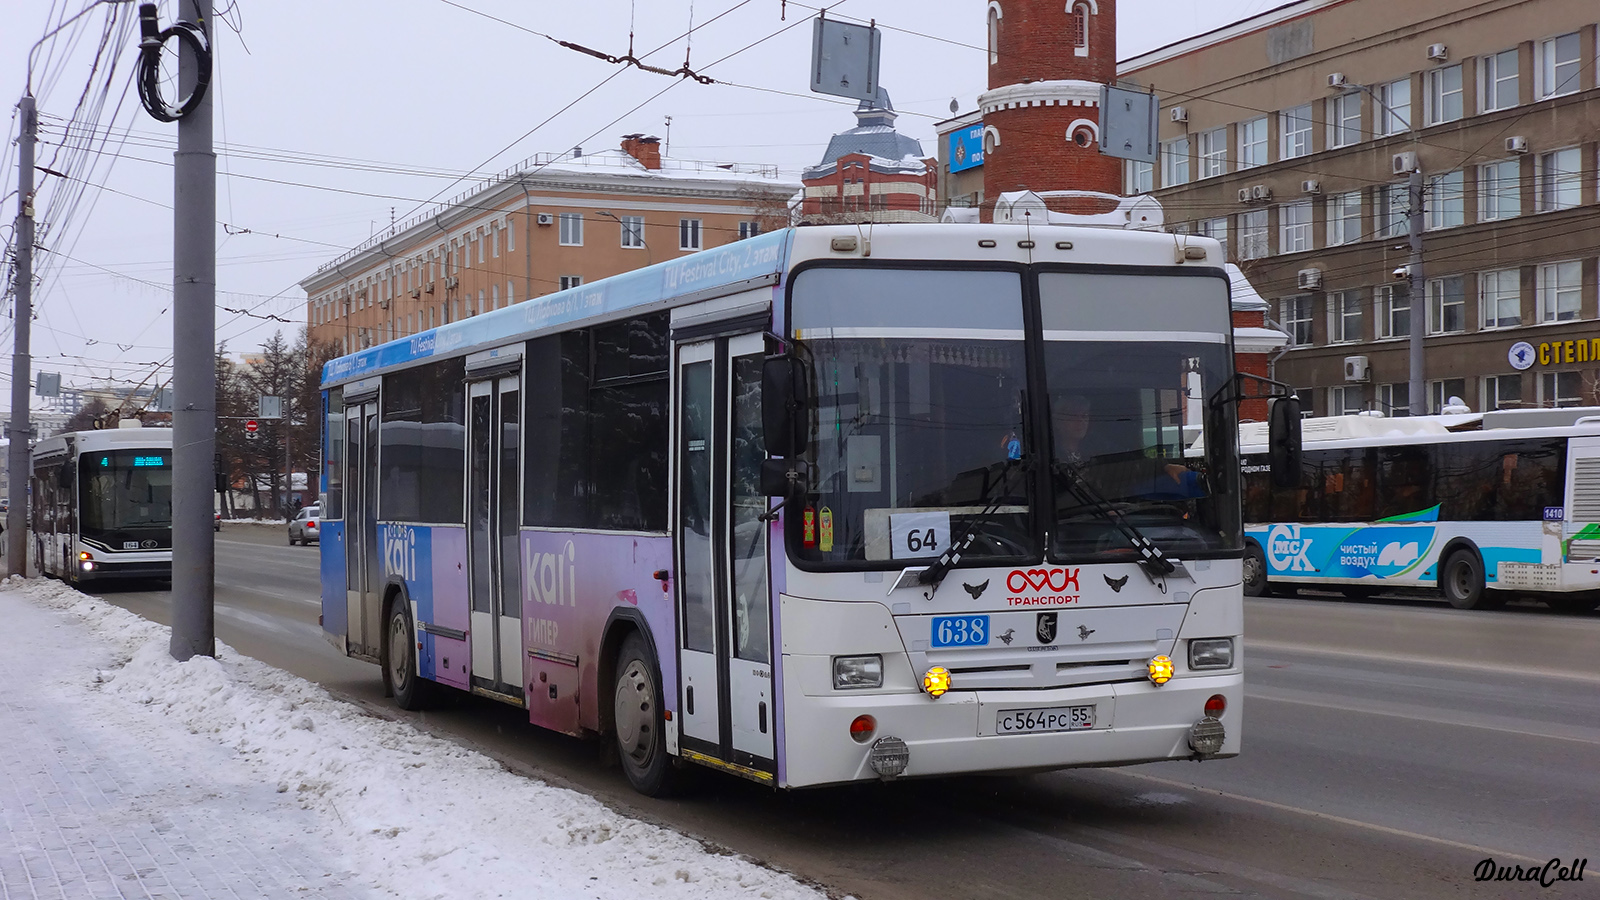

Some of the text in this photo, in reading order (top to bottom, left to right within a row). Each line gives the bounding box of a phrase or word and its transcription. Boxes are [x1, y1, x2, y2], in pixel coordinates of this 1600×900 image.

[664, 244, 780, 290] ТЦ Festival City, 2 этаж
[584, 292, 603, 308] этаж
[418, 333, 436, 352] Festival
[100, 457, 108, 467] 4
[1545, 508, 1563, 518] 1410
[907, 528, 938, 552] 64
[384, 528, 416, 582] kari
[526, 538, 576, 607] kari
[1006, 568, 1080, 594] ОМСК
[1007, 596, 1080, 606] ТРАНСПОРТ
[528, 617, 558, 646] ГИПЕР
[938, 618, 985, 644] 638
[1072, 708, 1088, 722] 55
